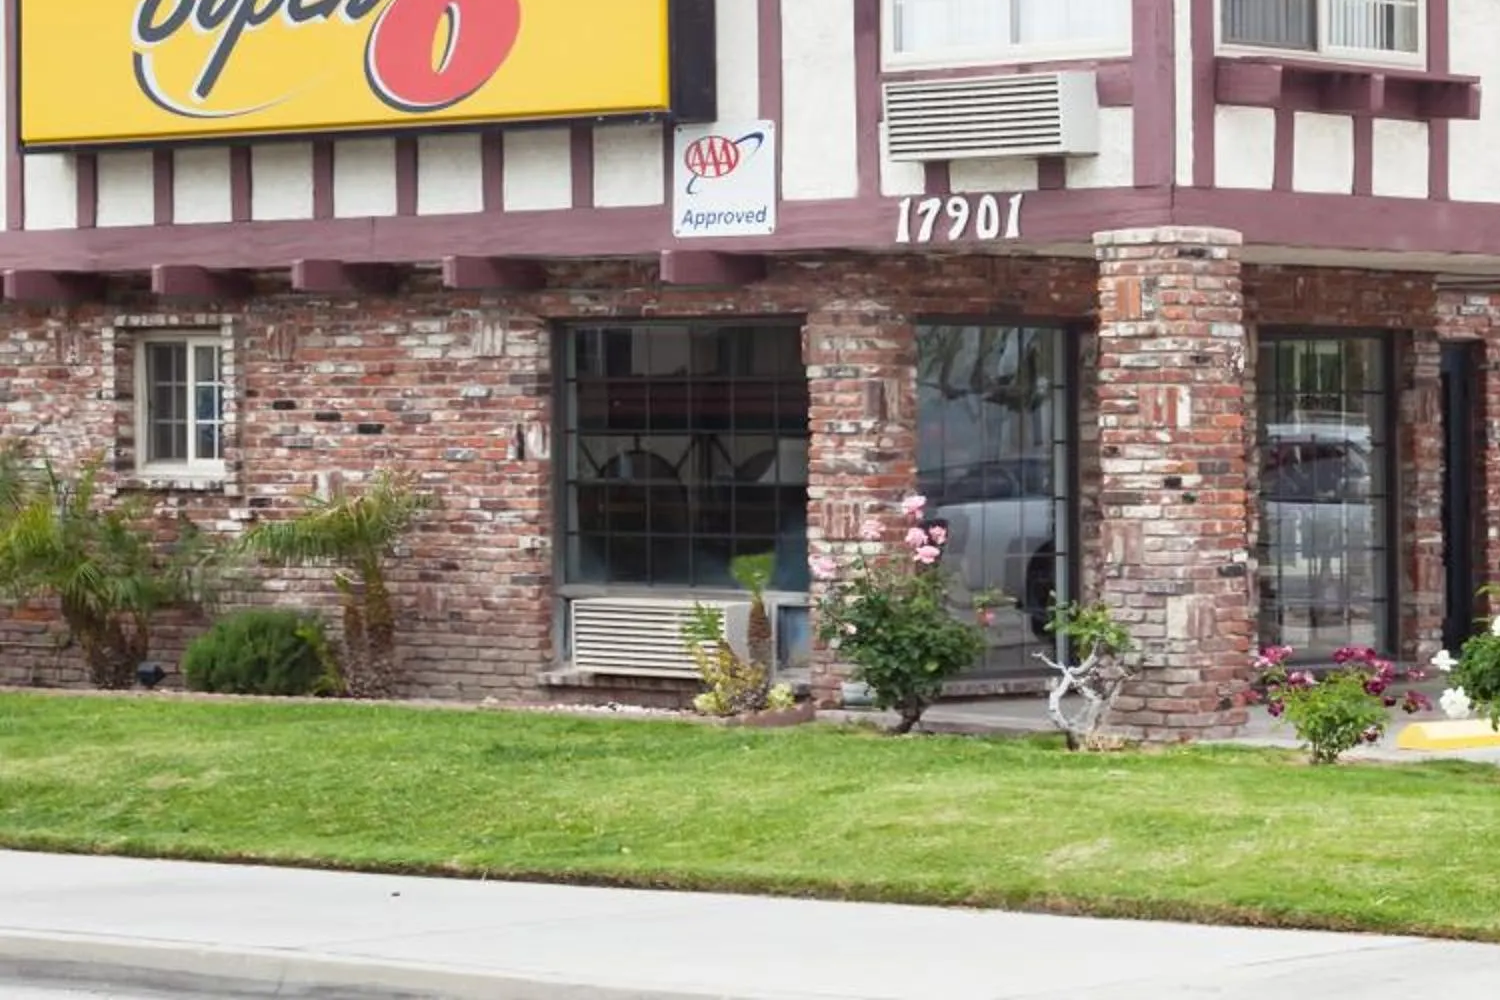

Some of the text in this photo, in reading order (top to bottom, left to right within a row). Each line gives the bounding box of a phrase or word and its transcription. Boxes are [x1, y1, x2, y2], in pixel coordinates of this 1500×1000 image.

[686, 136, 739, 177] AAA
[682, 206, 767, 230] Approved
[896, 194, 1023, 243] 17901
